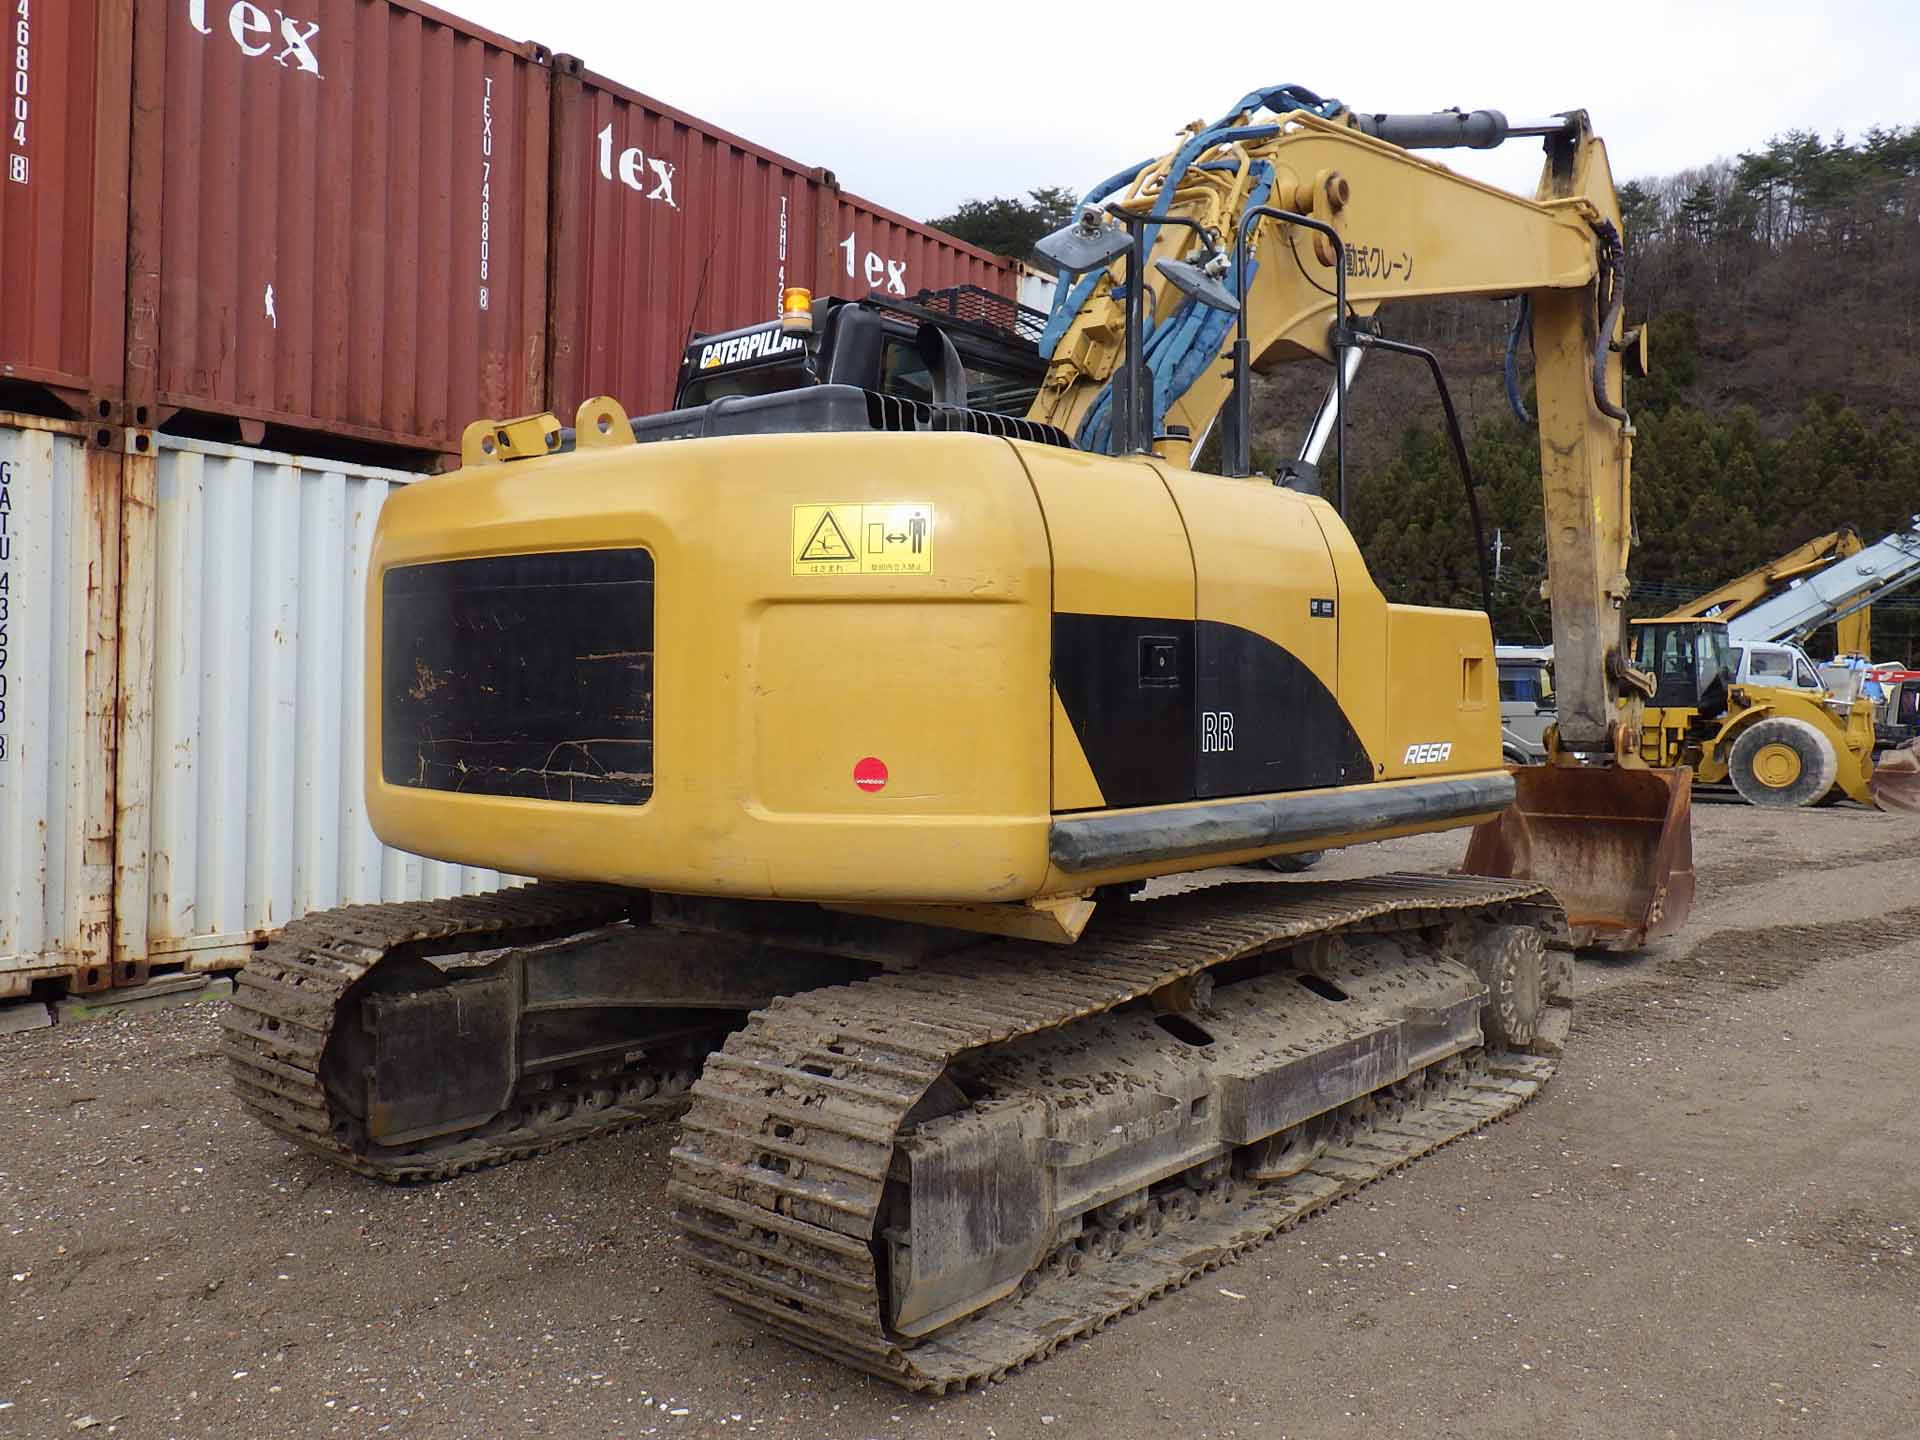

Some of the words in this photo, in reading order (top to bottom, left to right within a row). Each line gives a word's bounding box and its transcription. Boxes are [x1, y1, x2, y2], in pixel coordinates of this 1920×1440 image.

[483, 77, 492, 156] TEXU
[11, 155, 28, 183] 8
[480, 162, 490, 280] 748808
[0, 461, 11, 561] GATU
[1202, 711, 1234, 753] RR
